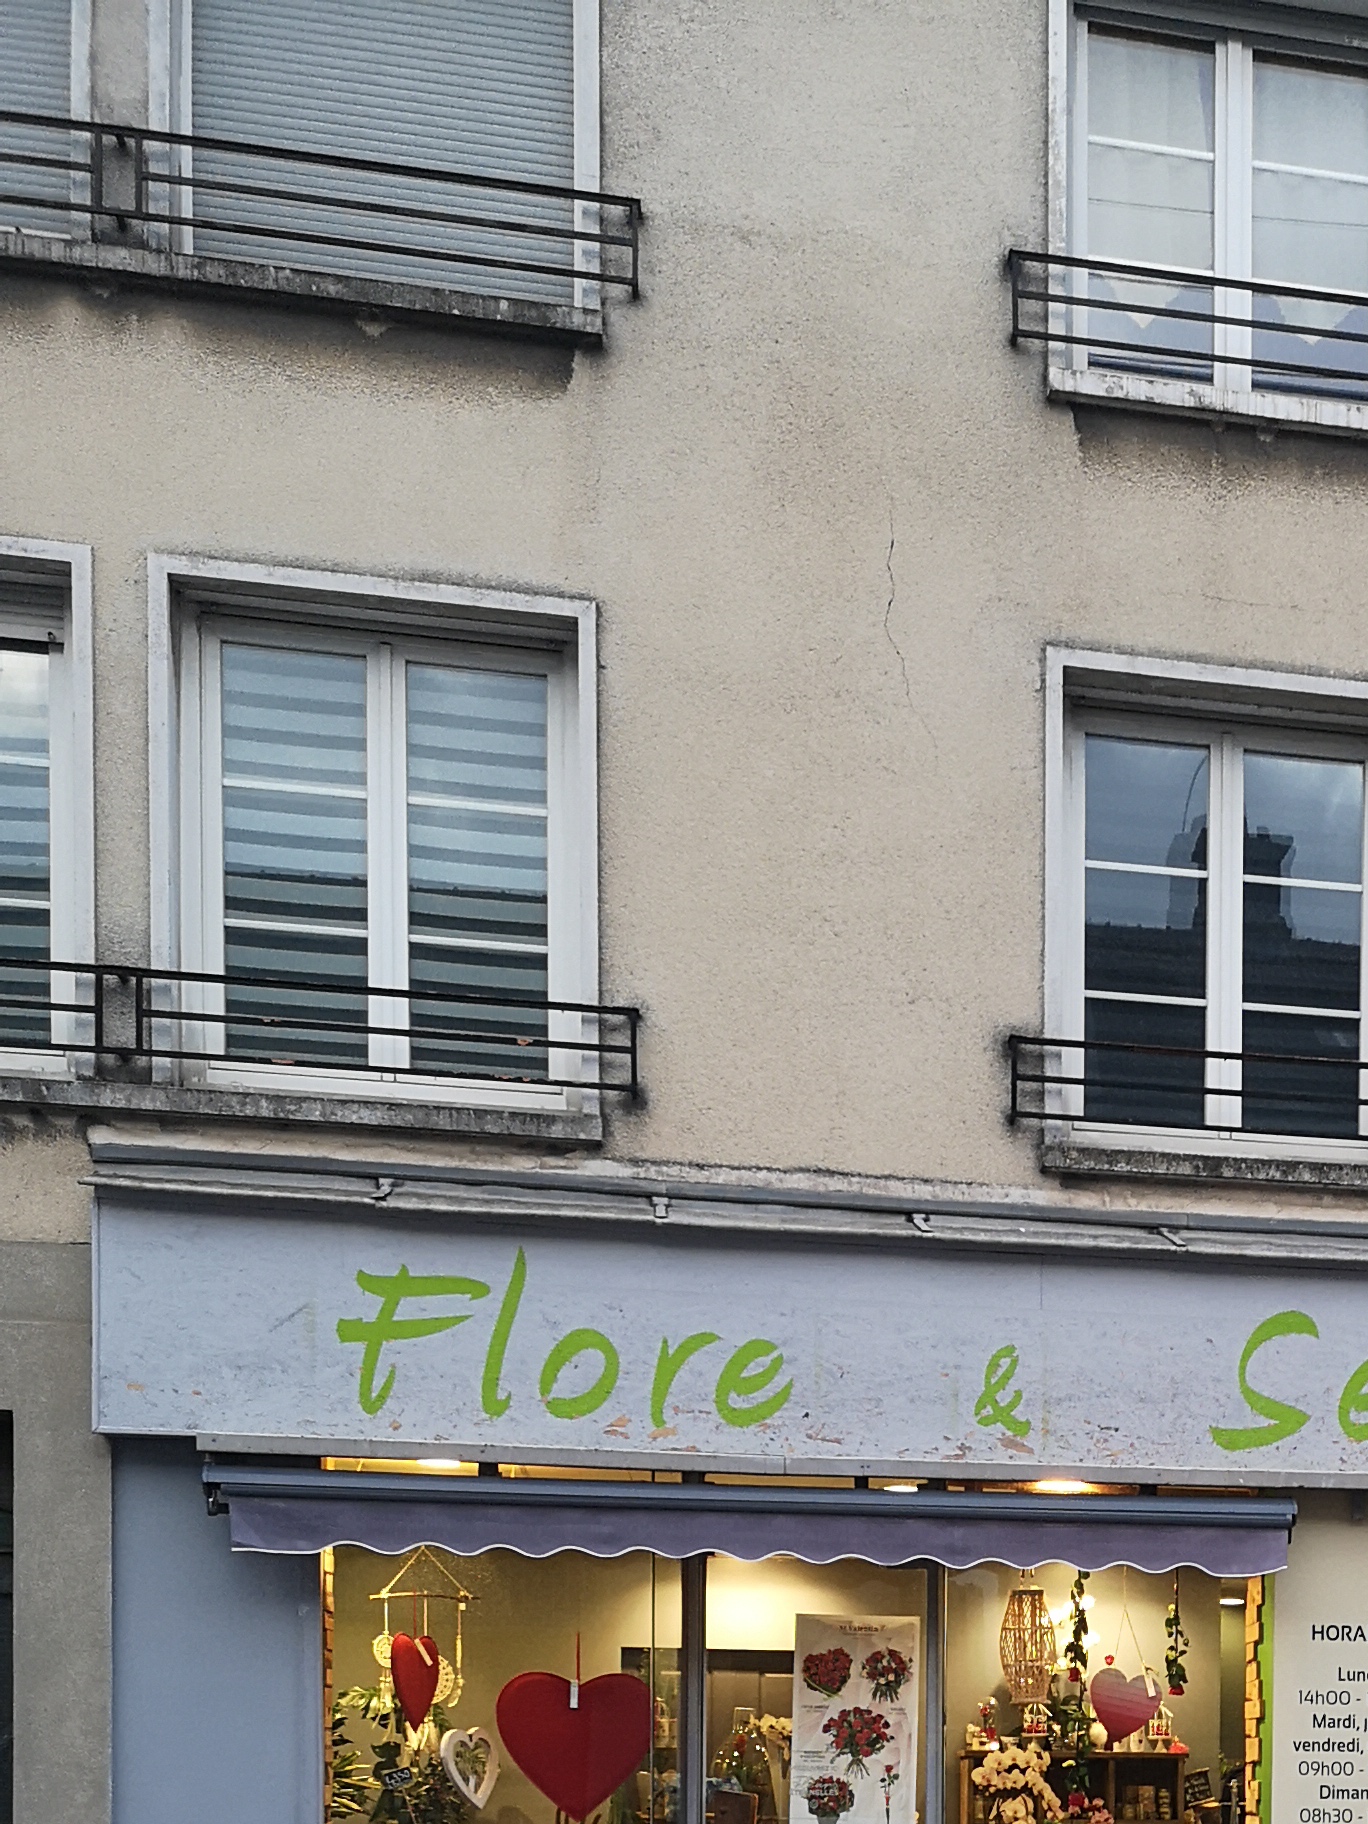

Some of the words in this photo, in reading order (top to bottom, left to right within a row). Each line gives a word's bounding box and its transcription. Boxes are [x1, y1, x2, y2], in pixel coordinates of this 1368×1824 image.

[336, 1246, 793, 1428] Flore
[975, 1344, 1031, 1438] &
[1298, 1689, 1351, 1706] 14h00
[1312, 1713, 1361, 1732] Mardi,
[1292, 1737, 1365, 1756] vendredi,
[1298, 1760, 1355, 1777] 09h00
[1299, 1807, 1353, 1824] 08h30
